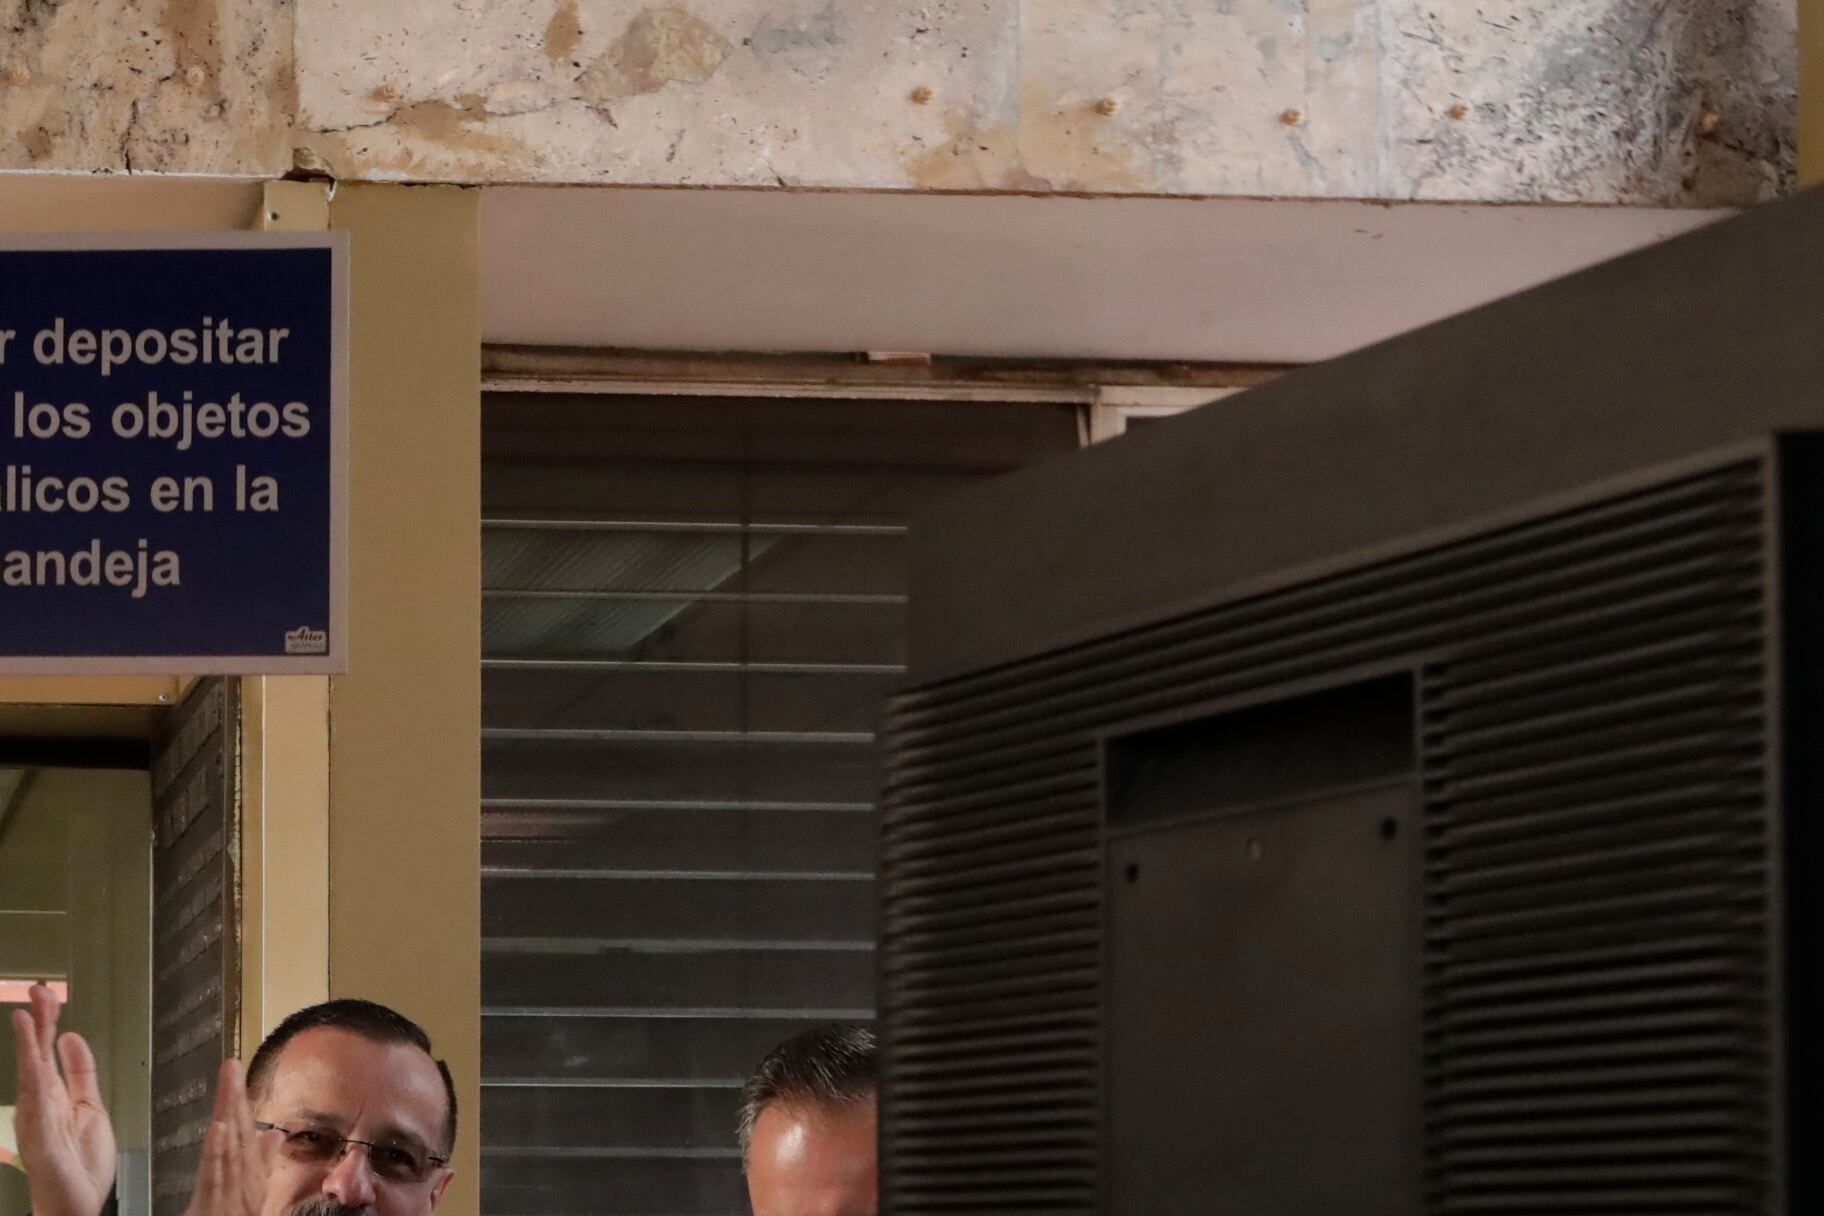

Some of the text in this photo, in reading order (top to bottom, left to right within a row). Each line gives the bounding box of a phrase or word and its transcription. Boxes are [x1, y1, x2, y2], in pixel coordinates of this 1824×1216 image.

[33, 317, 290, 376] depositar
[14, 391, 91, 439] los
[111, 390, 311, 450] objetos
[150, 475, 214, 512] en
[235, 464, 279, 512] la
